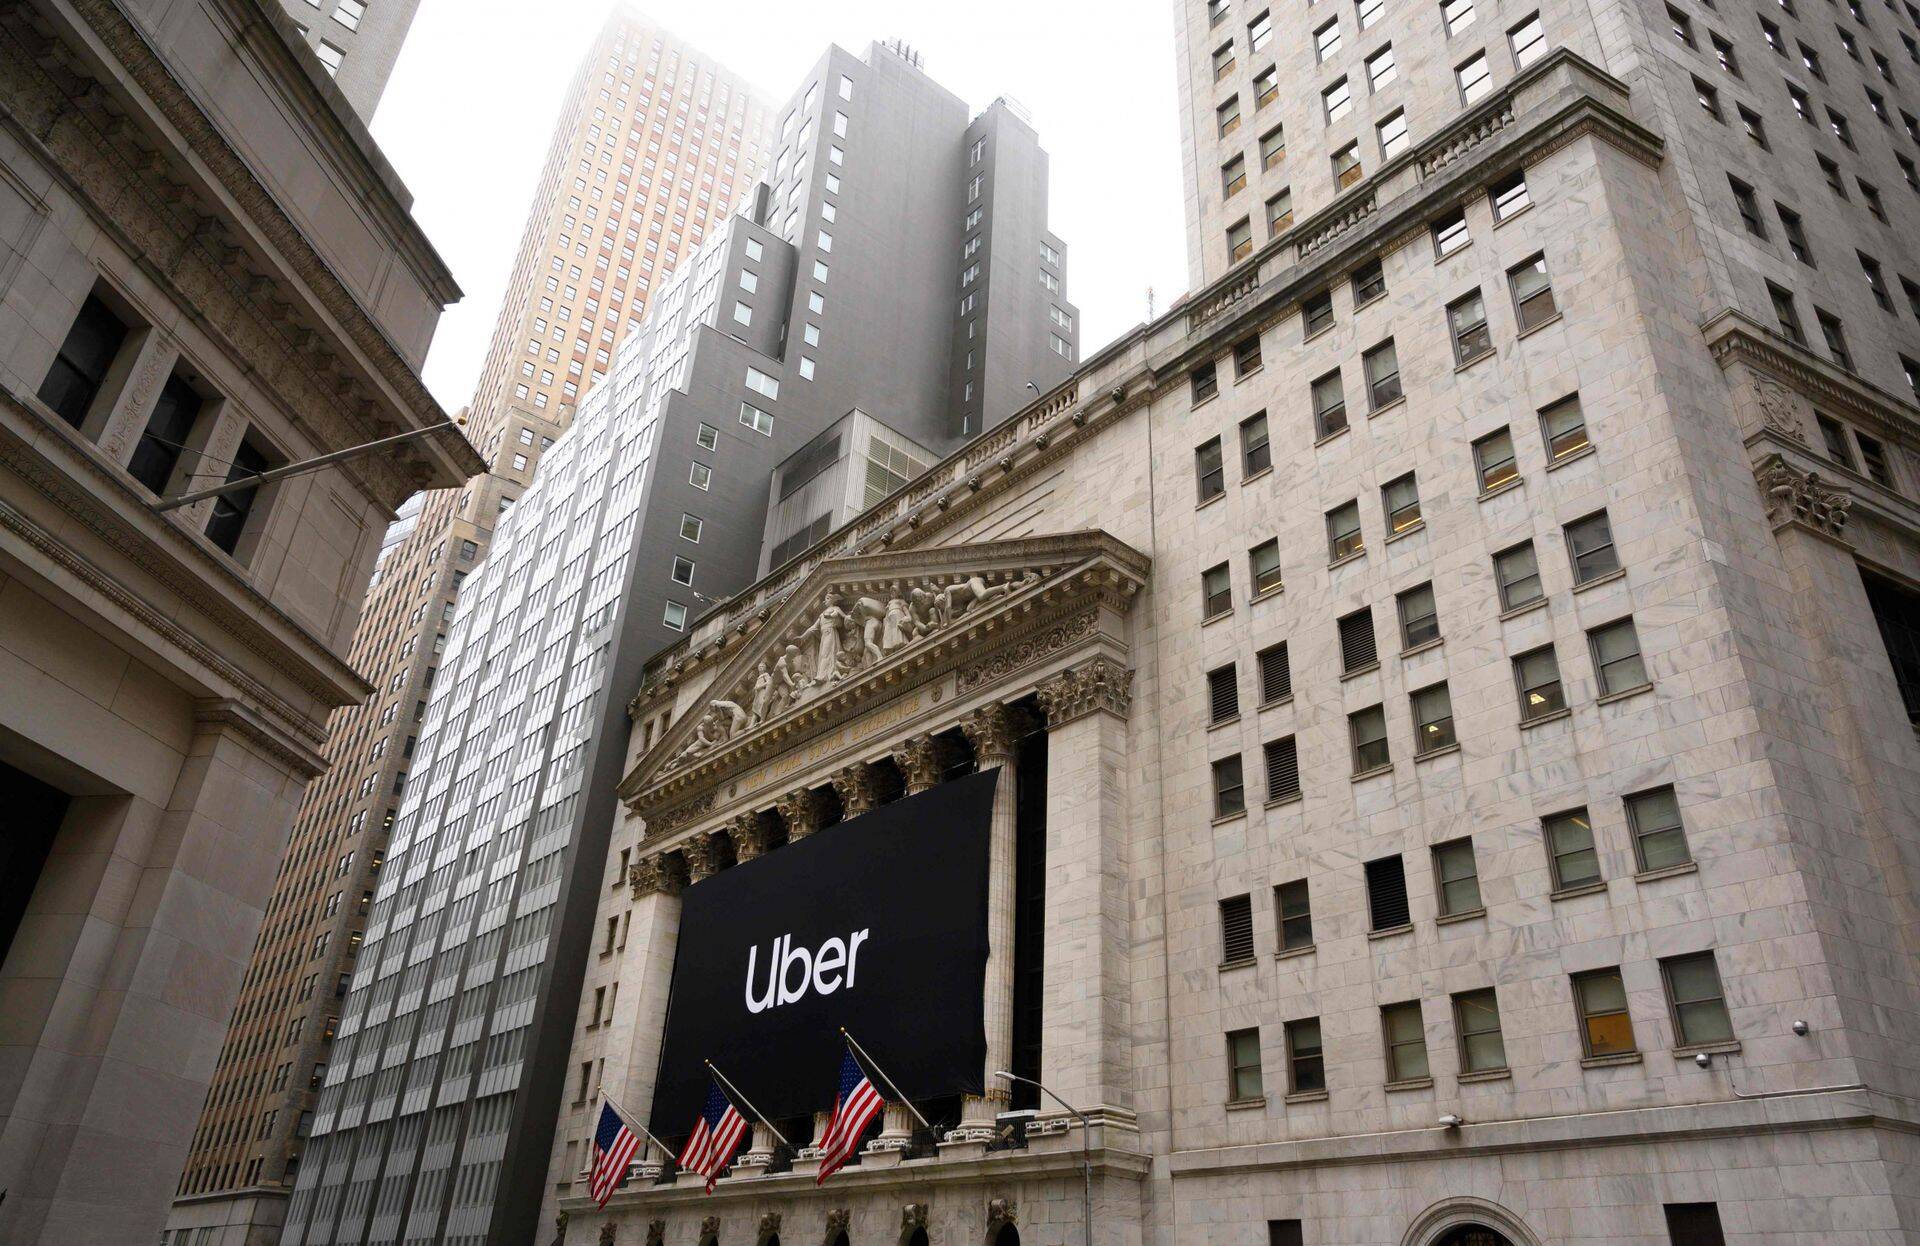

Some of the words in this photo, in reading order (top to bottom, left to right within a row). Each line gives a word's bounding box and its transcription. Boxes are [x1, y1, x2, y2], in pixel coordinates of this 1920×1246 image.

[745, 768, 768, 791] NEW
[775, 754, 802, 777] YORK
[808, 732, 845, 760] STOCK
[852, 696, 920, 740] EXCHANGE
[745, 928, 869, 1014] Uber
